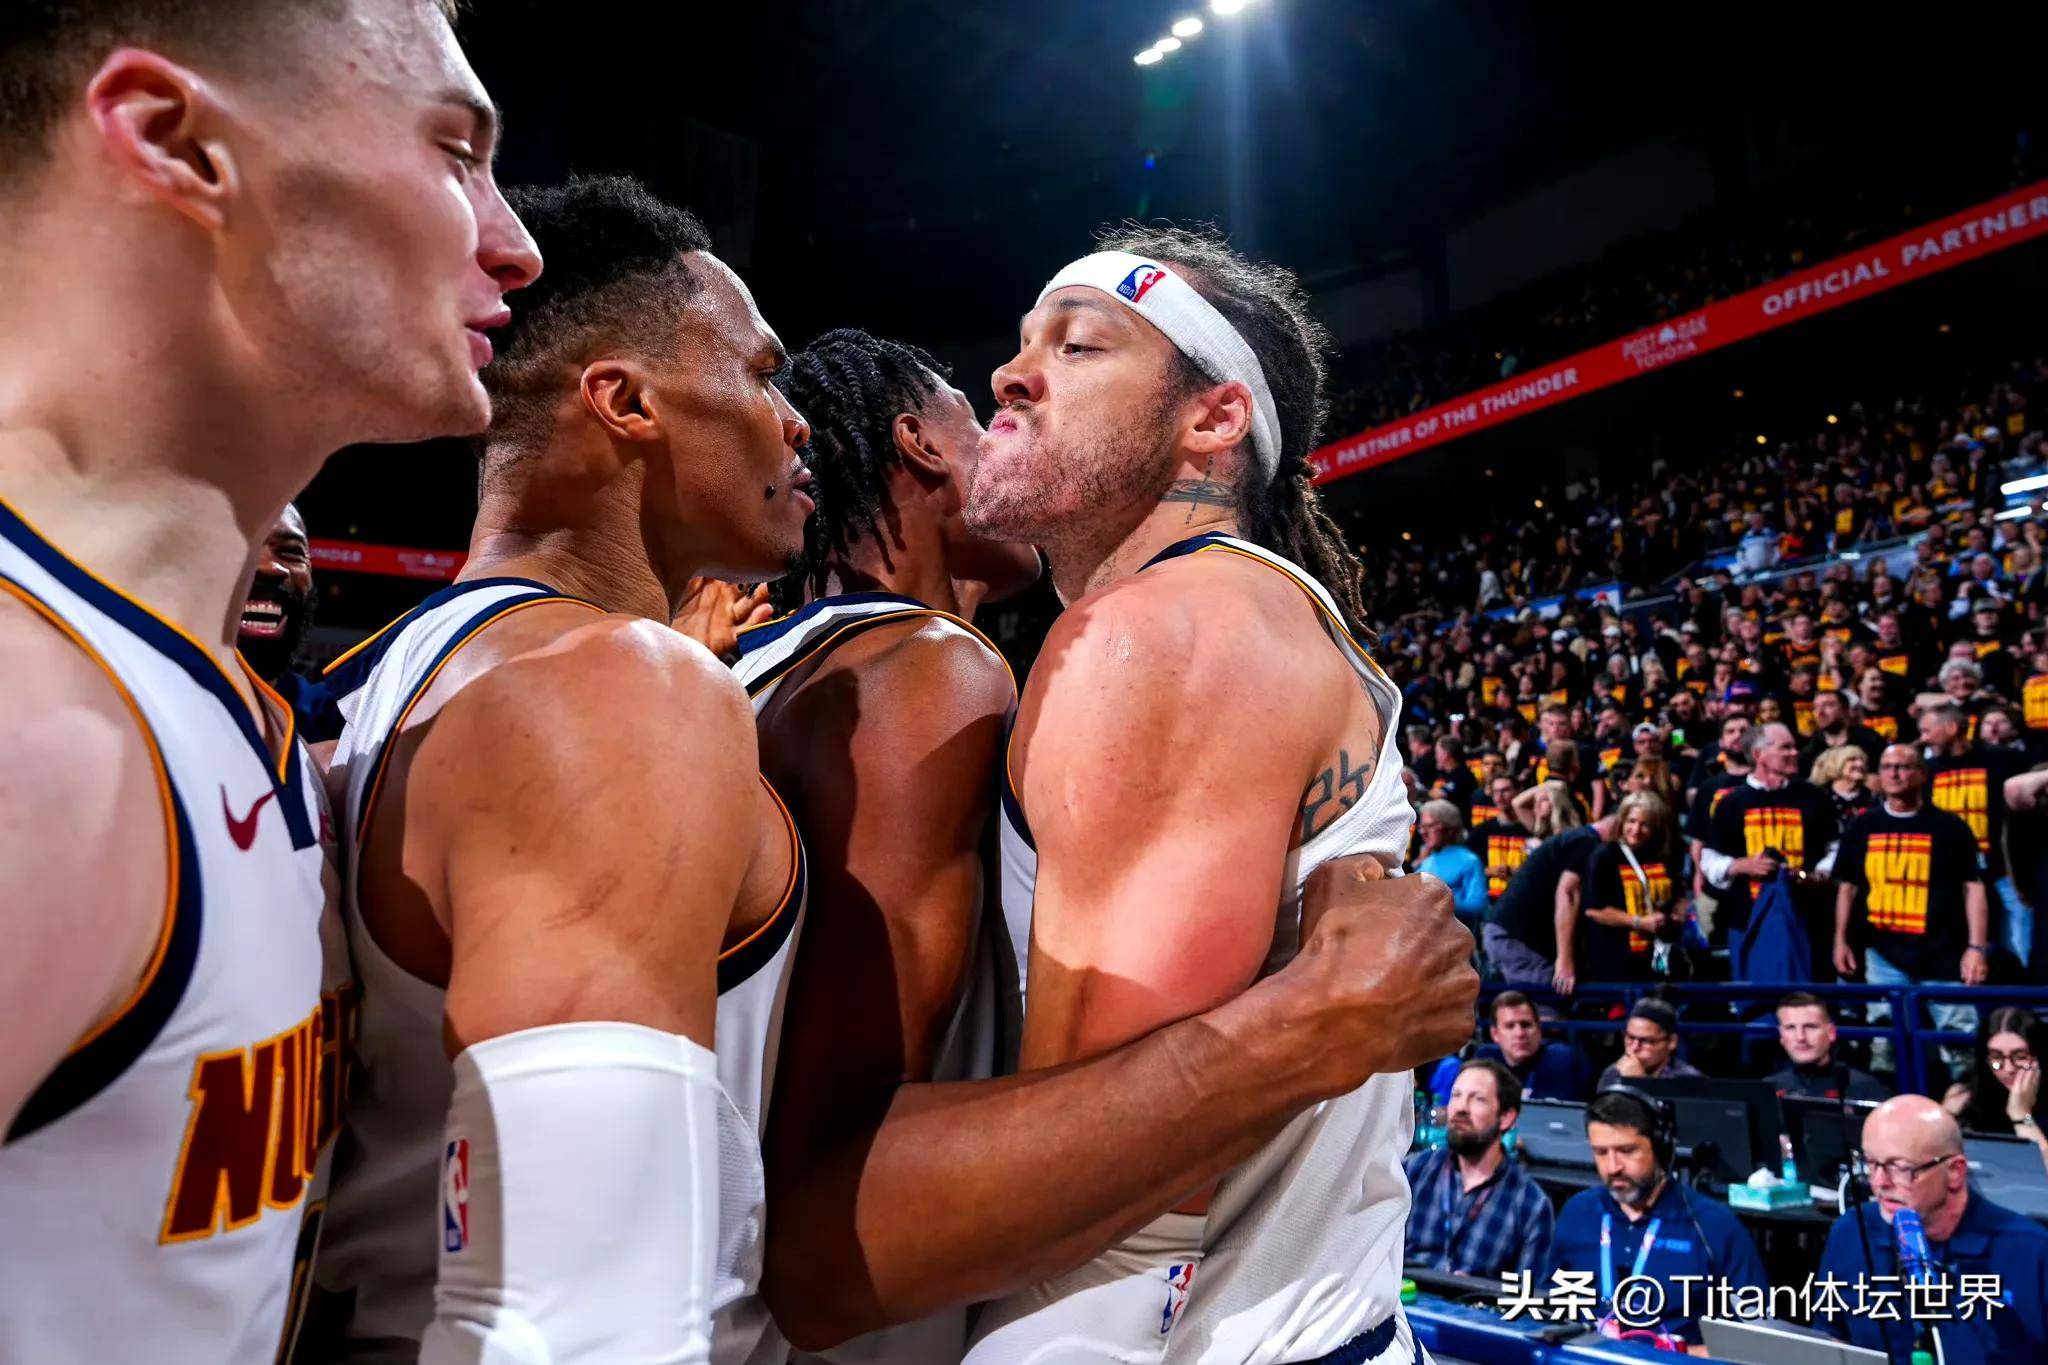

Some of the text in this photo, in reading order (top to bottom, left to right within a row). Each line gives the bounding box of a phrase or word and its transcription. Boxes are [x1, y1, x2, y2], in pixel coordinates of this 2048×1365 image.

[1118, 283, 1136, 297] NBA
[1762, 196, 2048, 316] OFFICIAL PARTNER
[1336, 427, 1412, 467] PARTNER
[1414, 418, 1438, 440] OF
[1442, 404, 1477, 430] THE
[1481, 367, 1579, 416] THUNDER
